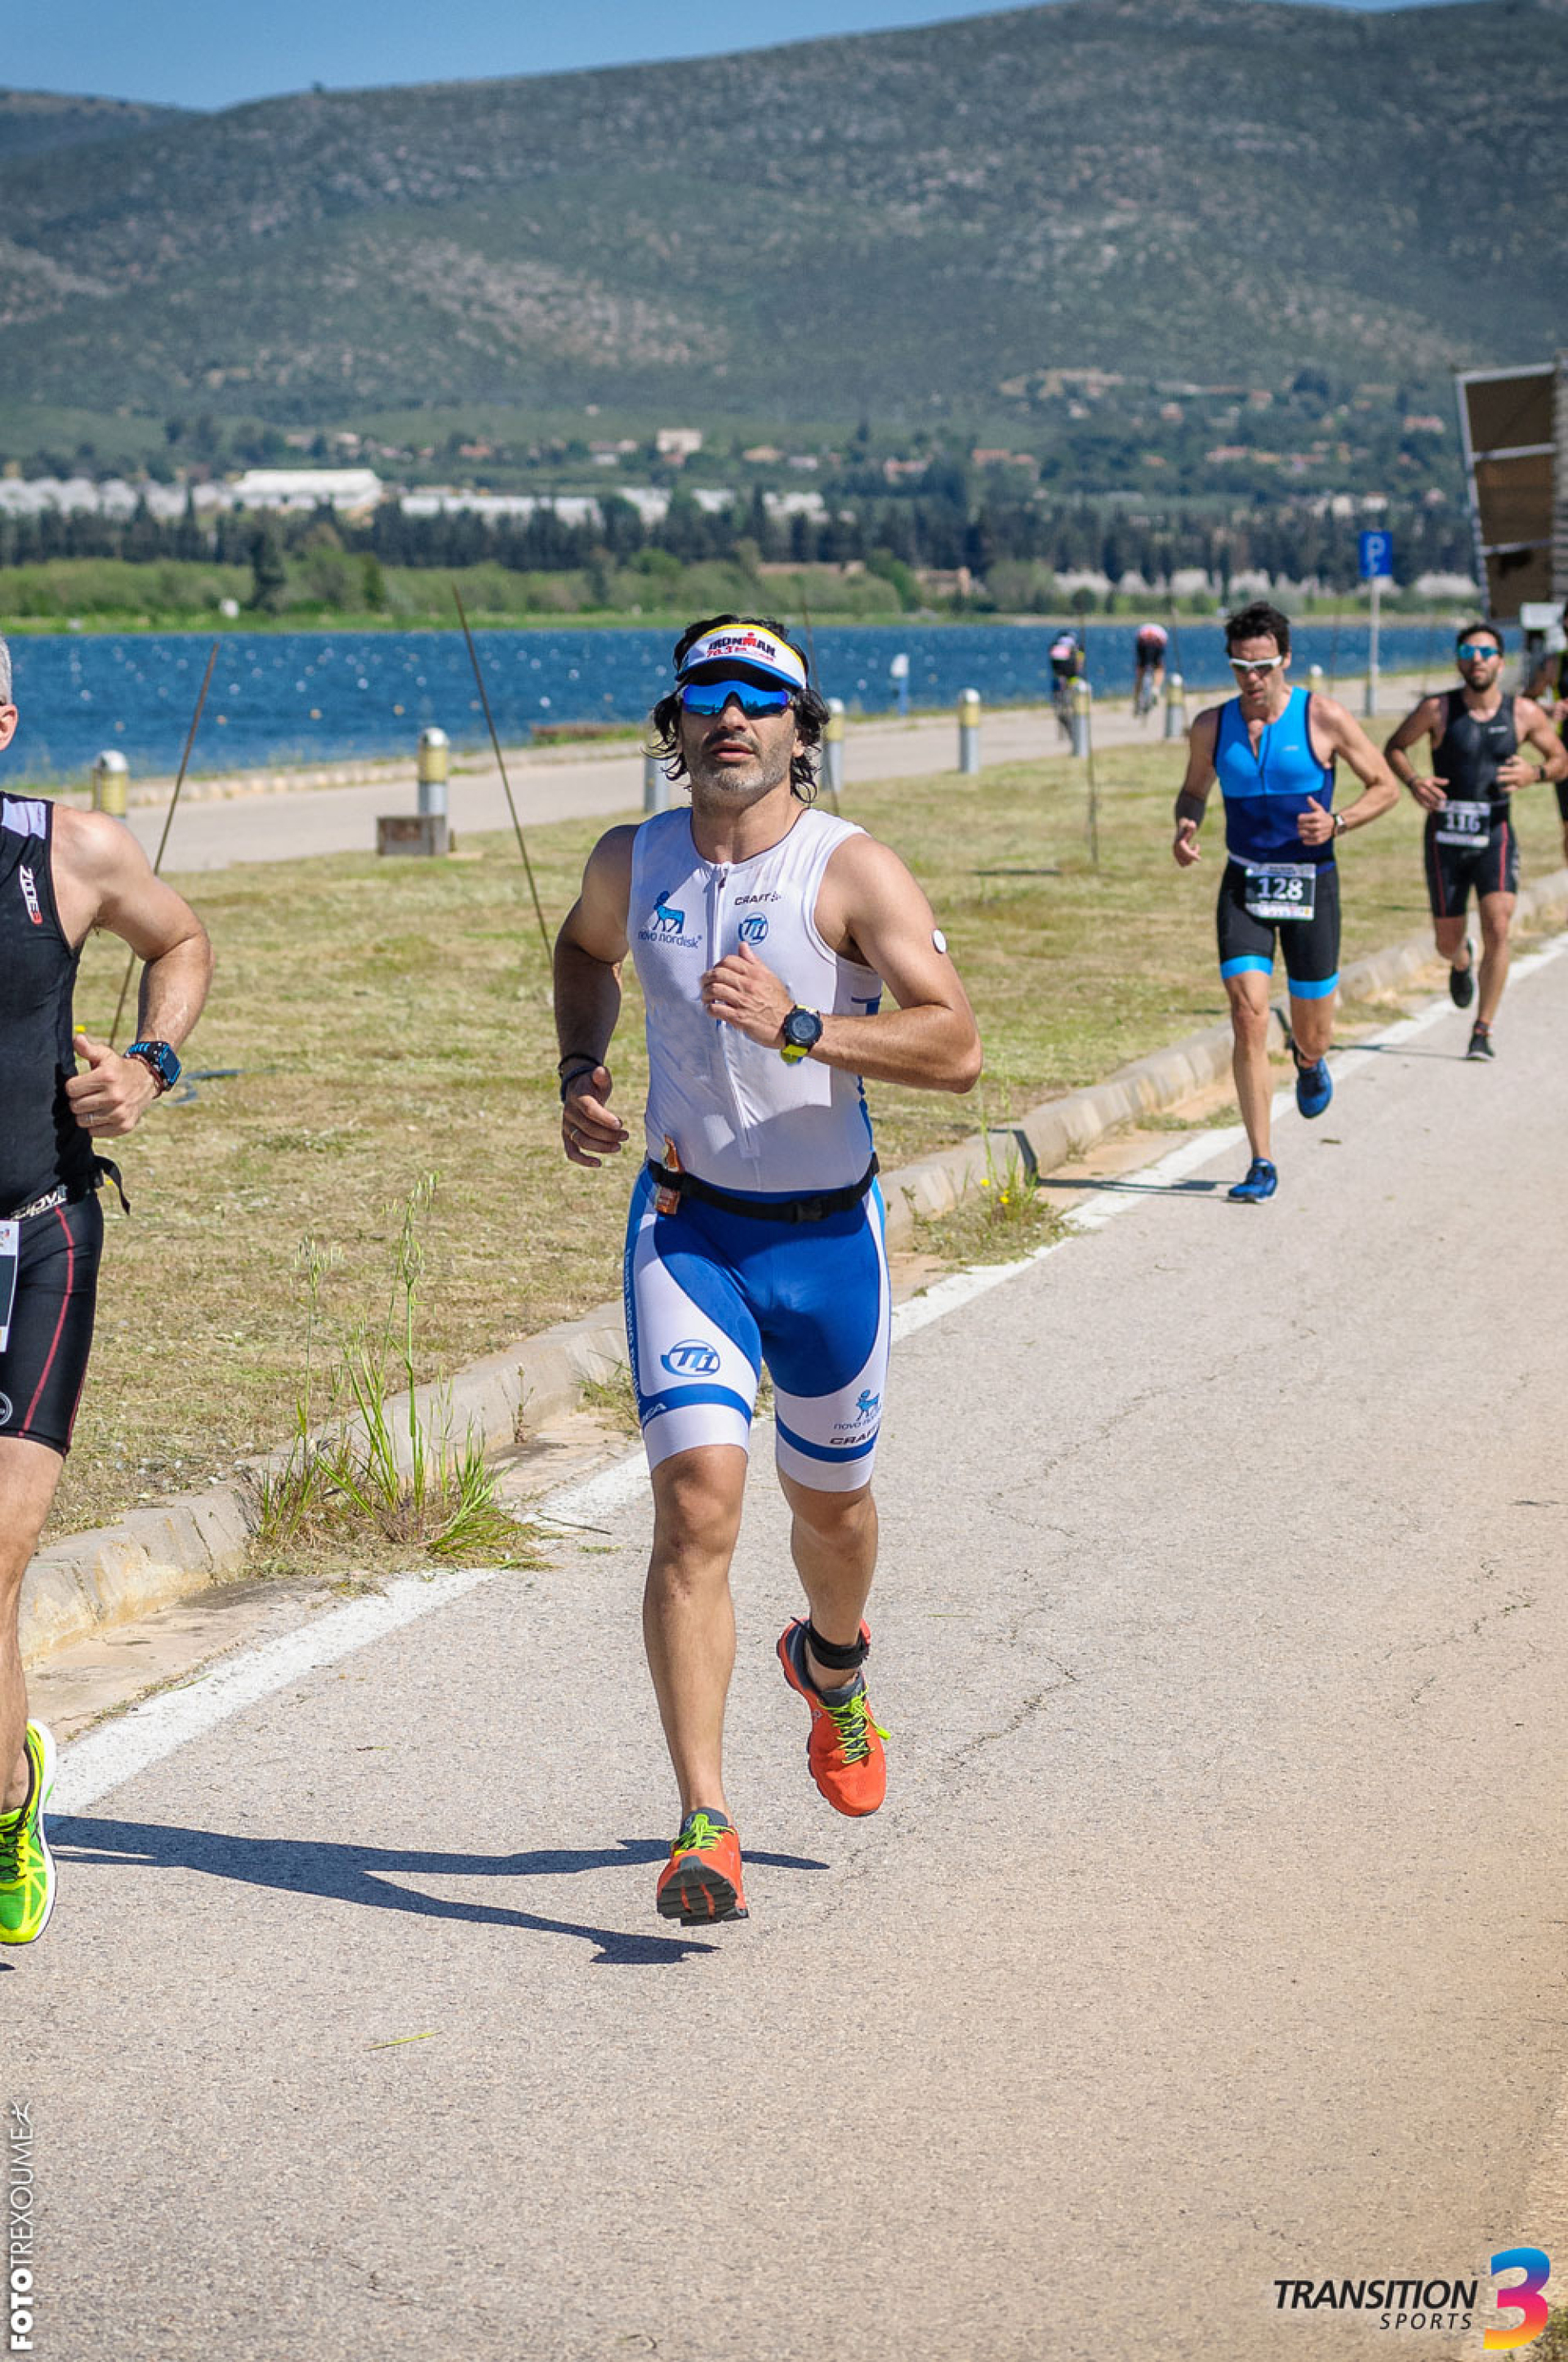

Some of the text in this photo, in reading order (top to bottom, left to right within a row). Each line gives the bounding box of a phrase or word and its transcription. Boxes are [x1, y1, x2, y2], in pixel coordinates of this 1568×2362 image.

[708, 632, 776, 657] IRONMAN
[1256, 877, 1303, 900] 128
[734, 893, 771, 906] CRAFT
[833, 1421, 862, 1431] novo
